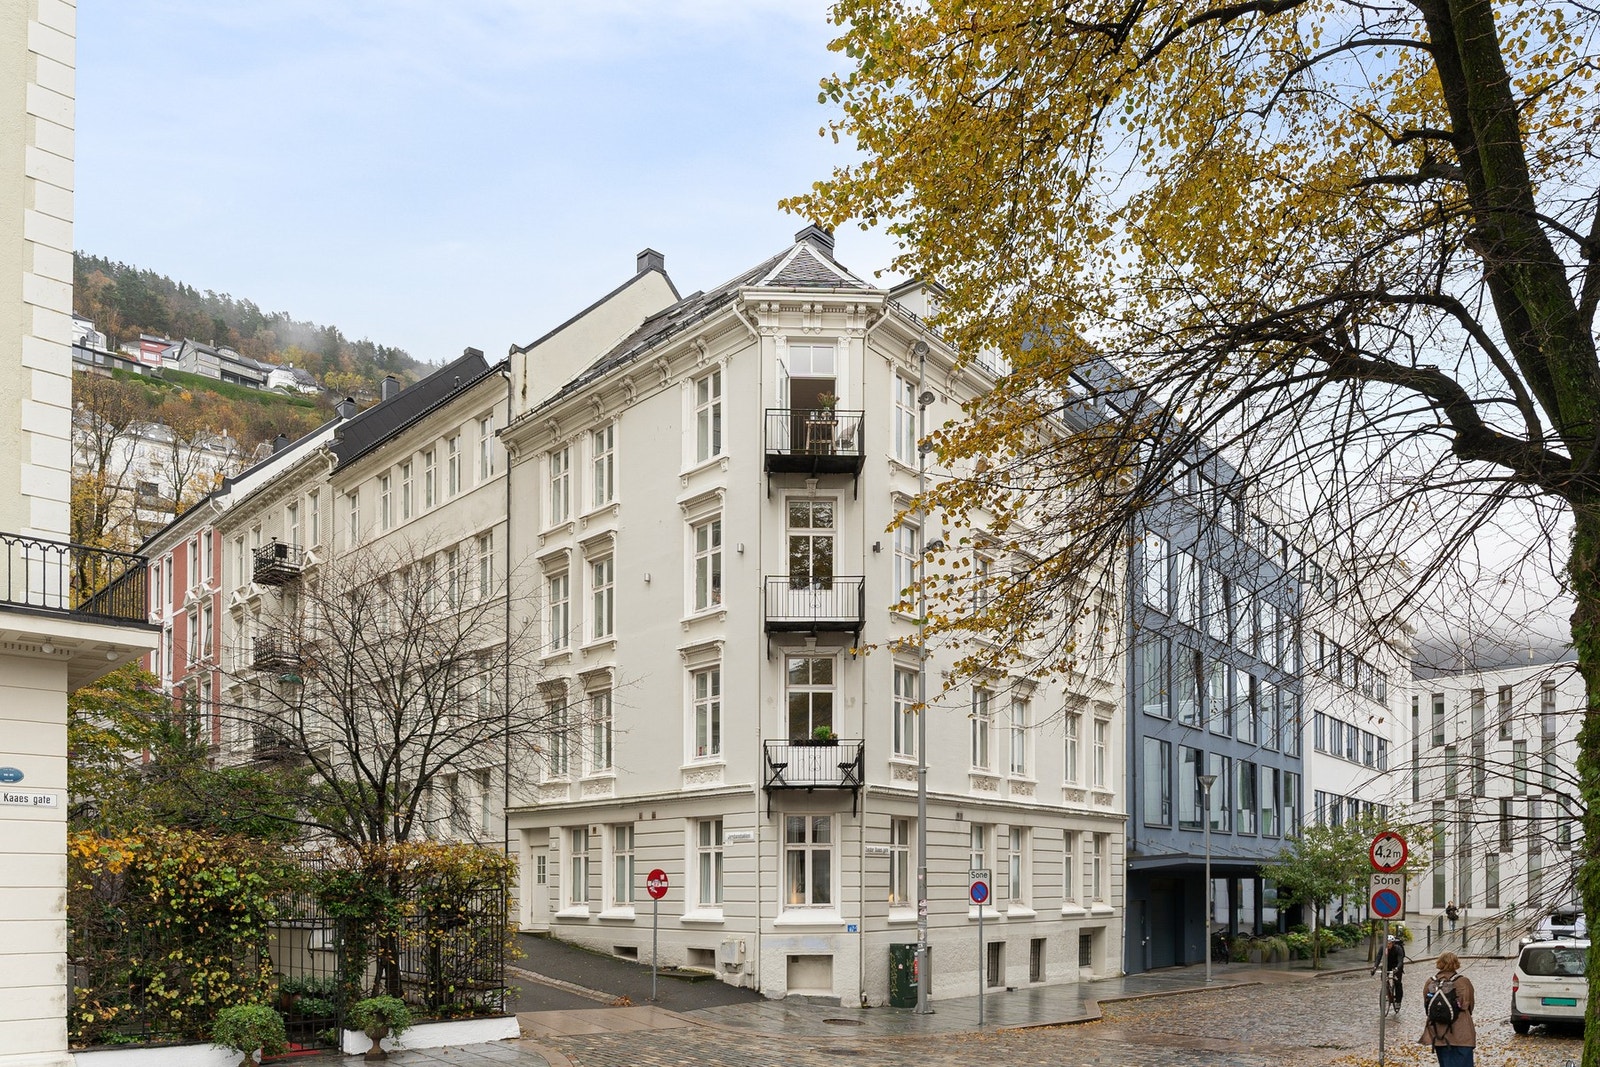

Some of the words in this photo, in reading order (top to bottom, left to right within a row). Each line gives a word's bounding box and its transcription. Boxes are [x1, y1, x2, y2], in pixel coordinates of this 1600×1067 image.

[3, 792, 29, 803] Kaaes
[33, 795, 51, 806] gate
[971, 871, 988, 879] Sone
[1373, 874, 1401, 885] Sone
